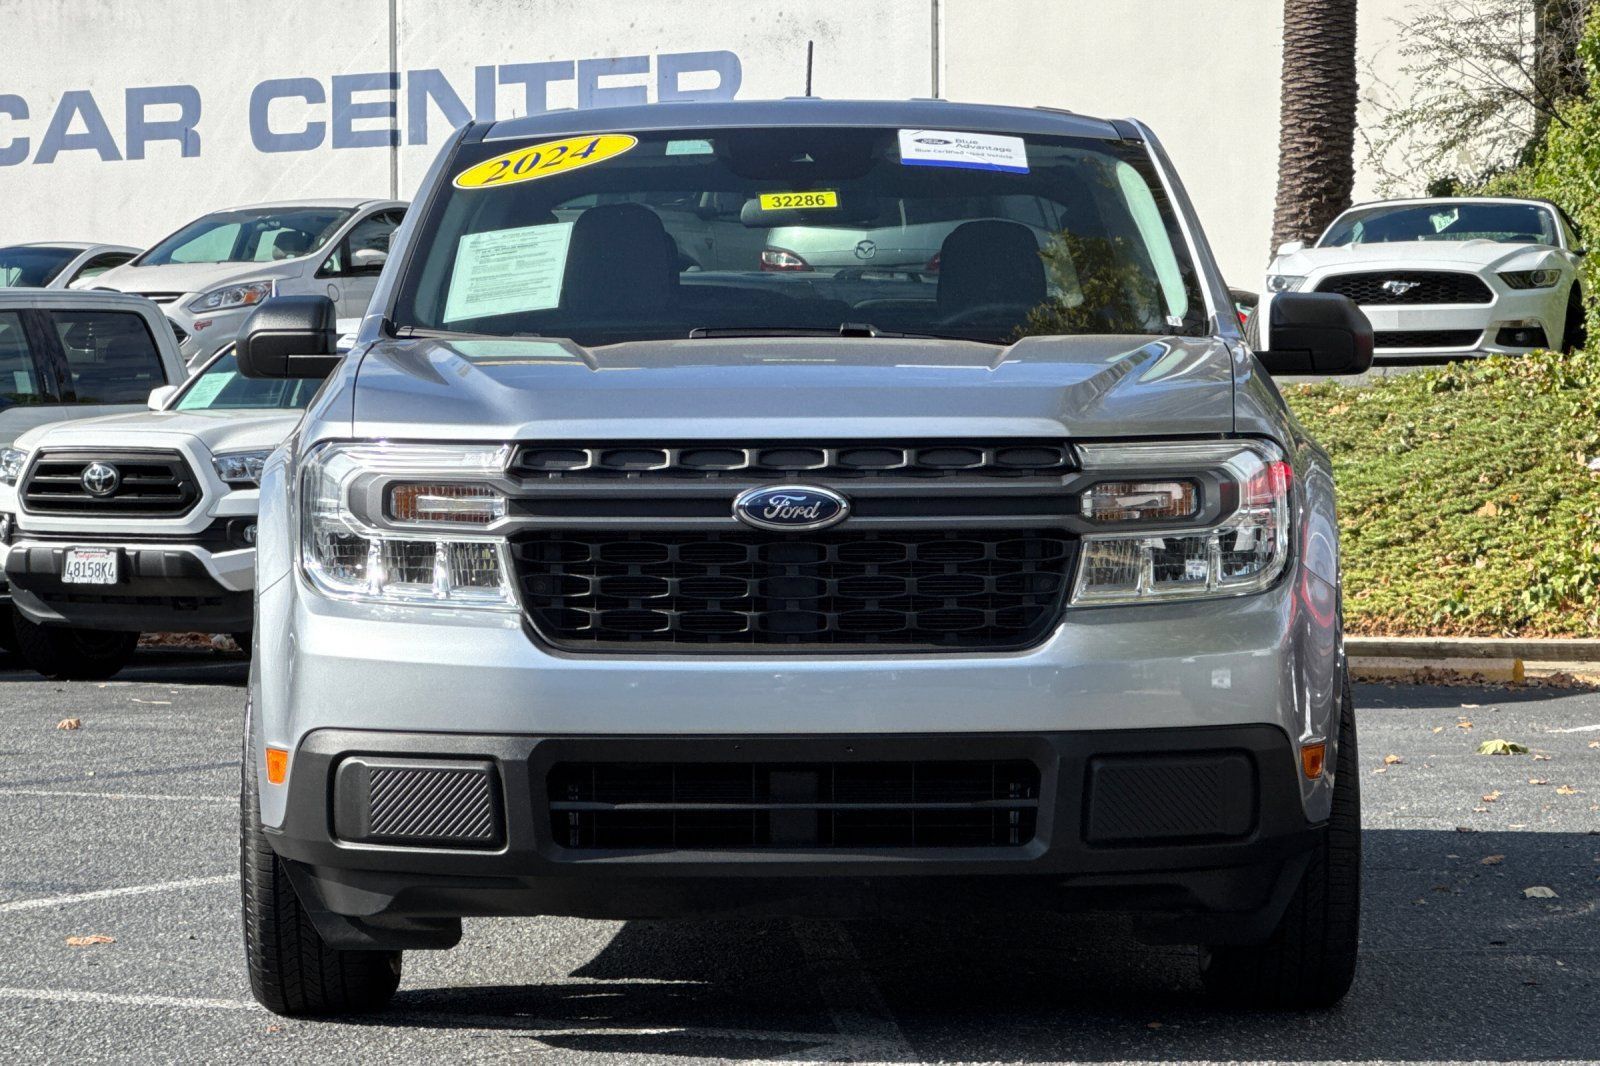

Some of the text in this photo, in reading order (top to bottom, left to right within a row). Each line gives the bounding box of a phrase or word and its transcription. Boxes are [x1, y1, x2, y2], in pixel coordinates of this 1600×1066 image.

[248, 50, 742, 154] CENTER
[955, 143, 1012, 153] Advantage
[481, 137, 602, 185] 2024
[772, 194, 826, 209] 32286
[763, 495, 821, 519] Ford
[66, 561, 114, 578] 48158K4
